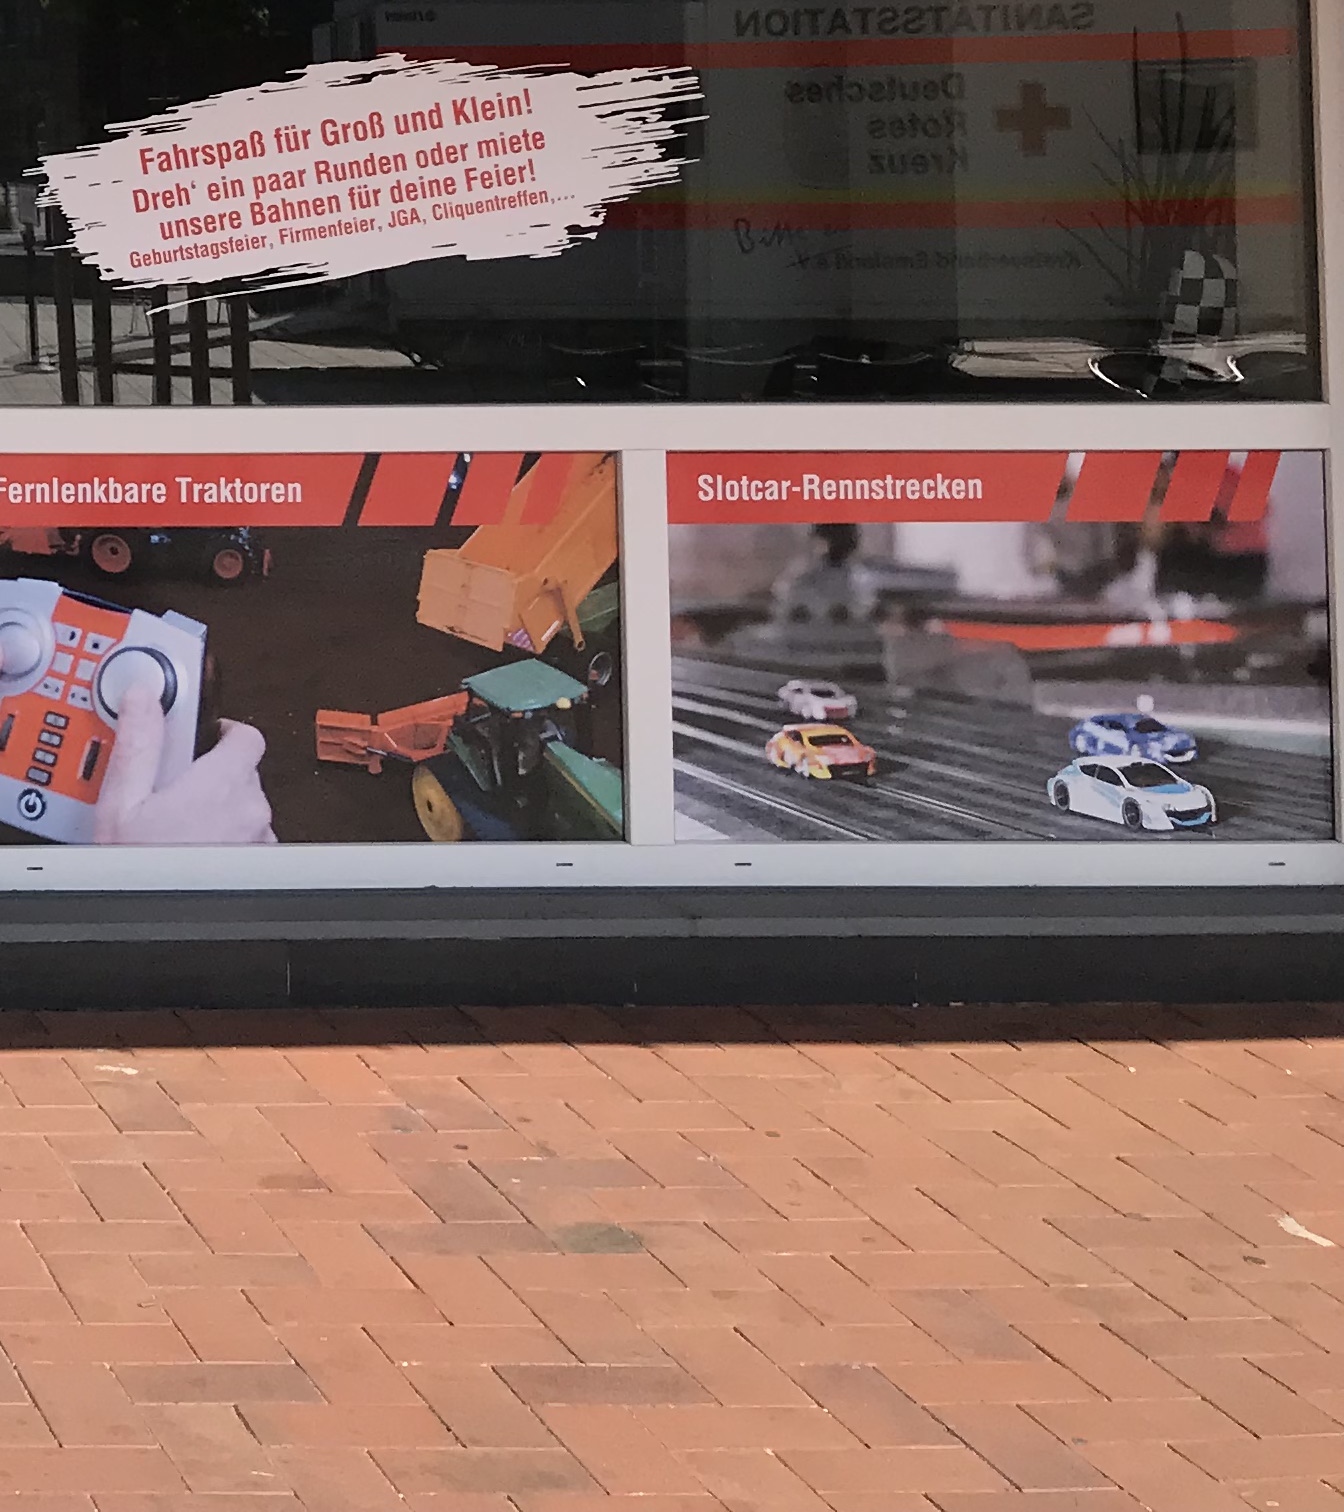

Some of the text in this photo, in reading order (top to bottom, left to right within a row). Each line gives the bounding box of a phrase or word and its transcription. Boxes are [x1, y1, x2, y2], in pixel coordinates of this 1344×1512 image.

[138, 88, 534, 176] Fahrspaß für Groß und Klein!
[206, 175, 246, 204] ein
[253, 167, 307, 202] paar
[314, 152, 408, 186] Runden
[415, 143, 470, 172] oder
[477, 128, 546, 159] miete
[159, 158, 537, 242] unsere Bahnen für deine Feier!
[129, 232, 275, 269] Geburtstagsfeier,
[279, 215, 384, 247] Firmenfeier,
[387, 207, 428, 230] JGA,
[175, 477, 303, 503] Traktoren
[697, 473, 983, 501] Slotcar-Rennstrecken
